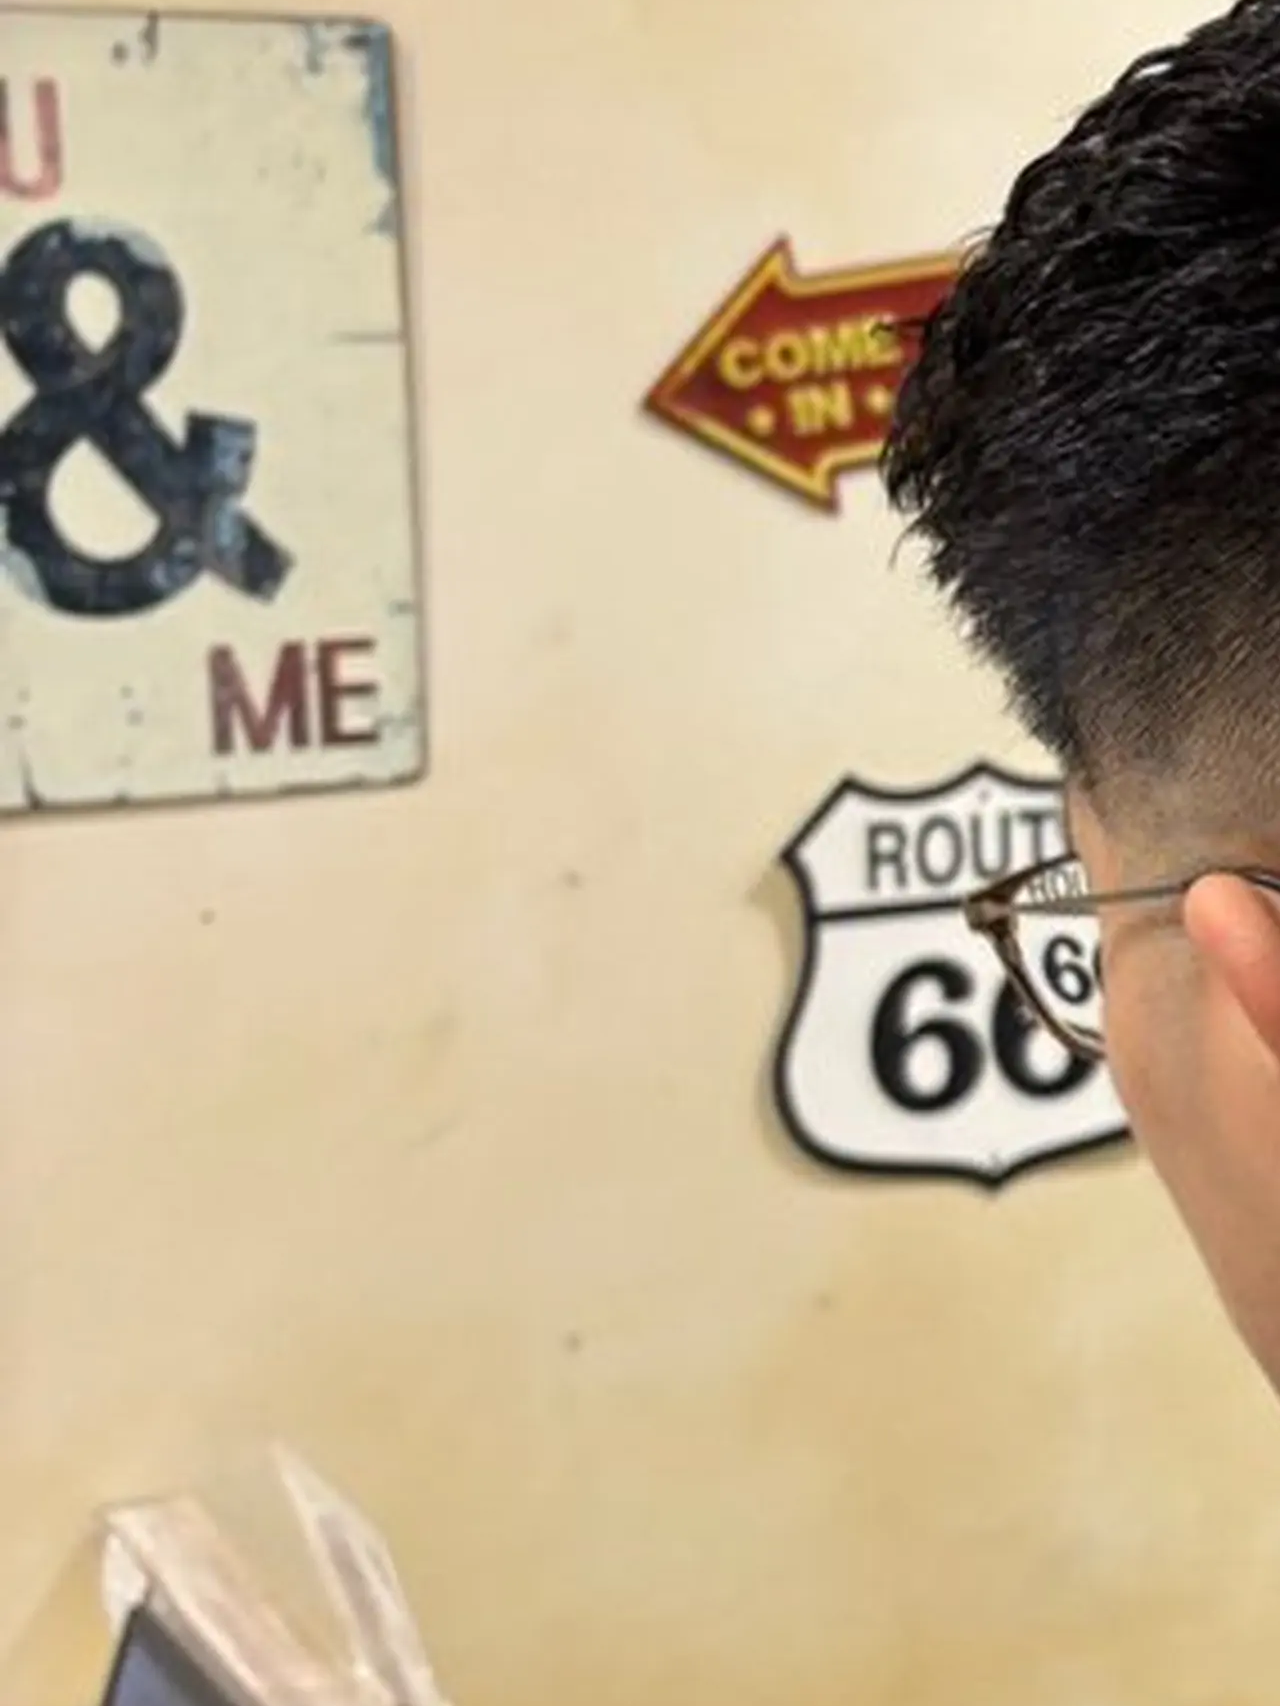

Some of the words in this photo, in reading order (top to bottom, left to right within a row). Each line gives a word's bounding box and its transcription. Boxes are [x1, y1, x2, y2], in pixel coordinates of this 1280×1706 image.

[718, 310, 903, 389] COME
[0, 219, 295, 619] &
[788, 379, 854, 436] IN
[208, 638, 380, 757] ME
[866, 809, 1062, 891] ROUT
